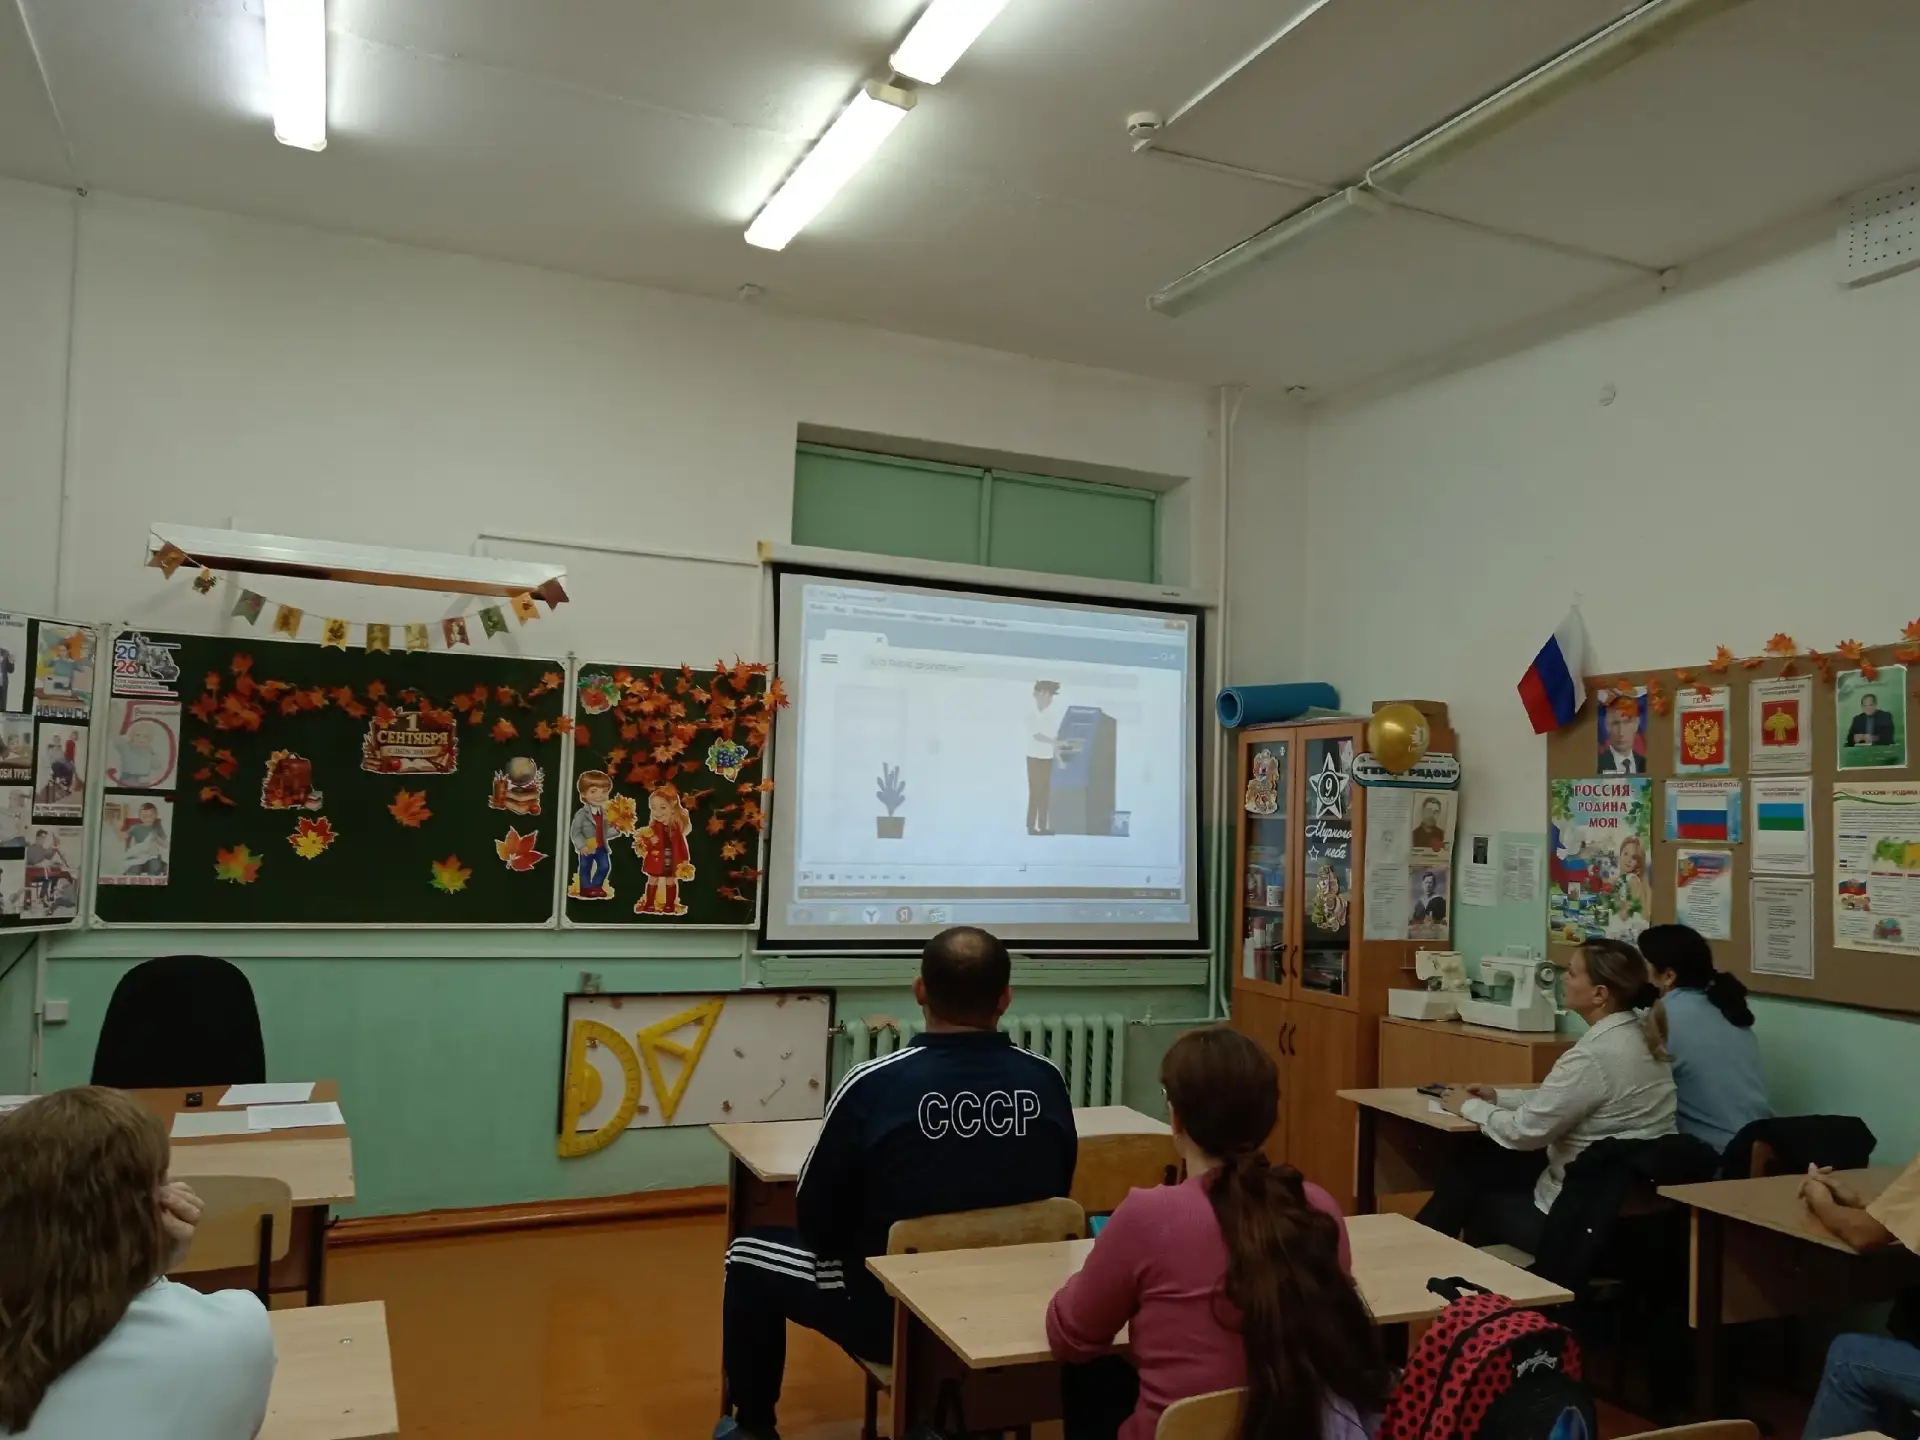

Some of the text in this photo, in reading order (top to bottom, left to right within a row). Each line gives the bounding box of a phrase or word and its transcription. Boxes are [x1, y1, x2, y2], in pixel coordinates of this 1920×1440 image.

[406, 713, 419, 731] 1
[377, 730, 448, 744] СЕНТЯБРЯ
[1325, 777, 1333, 797] 9
[1578, 801, 1628, 813] РОДИНА
[1589, 817, 1618, 829] МОЯ!
[918, 1090, 1040, 1139] СССР
